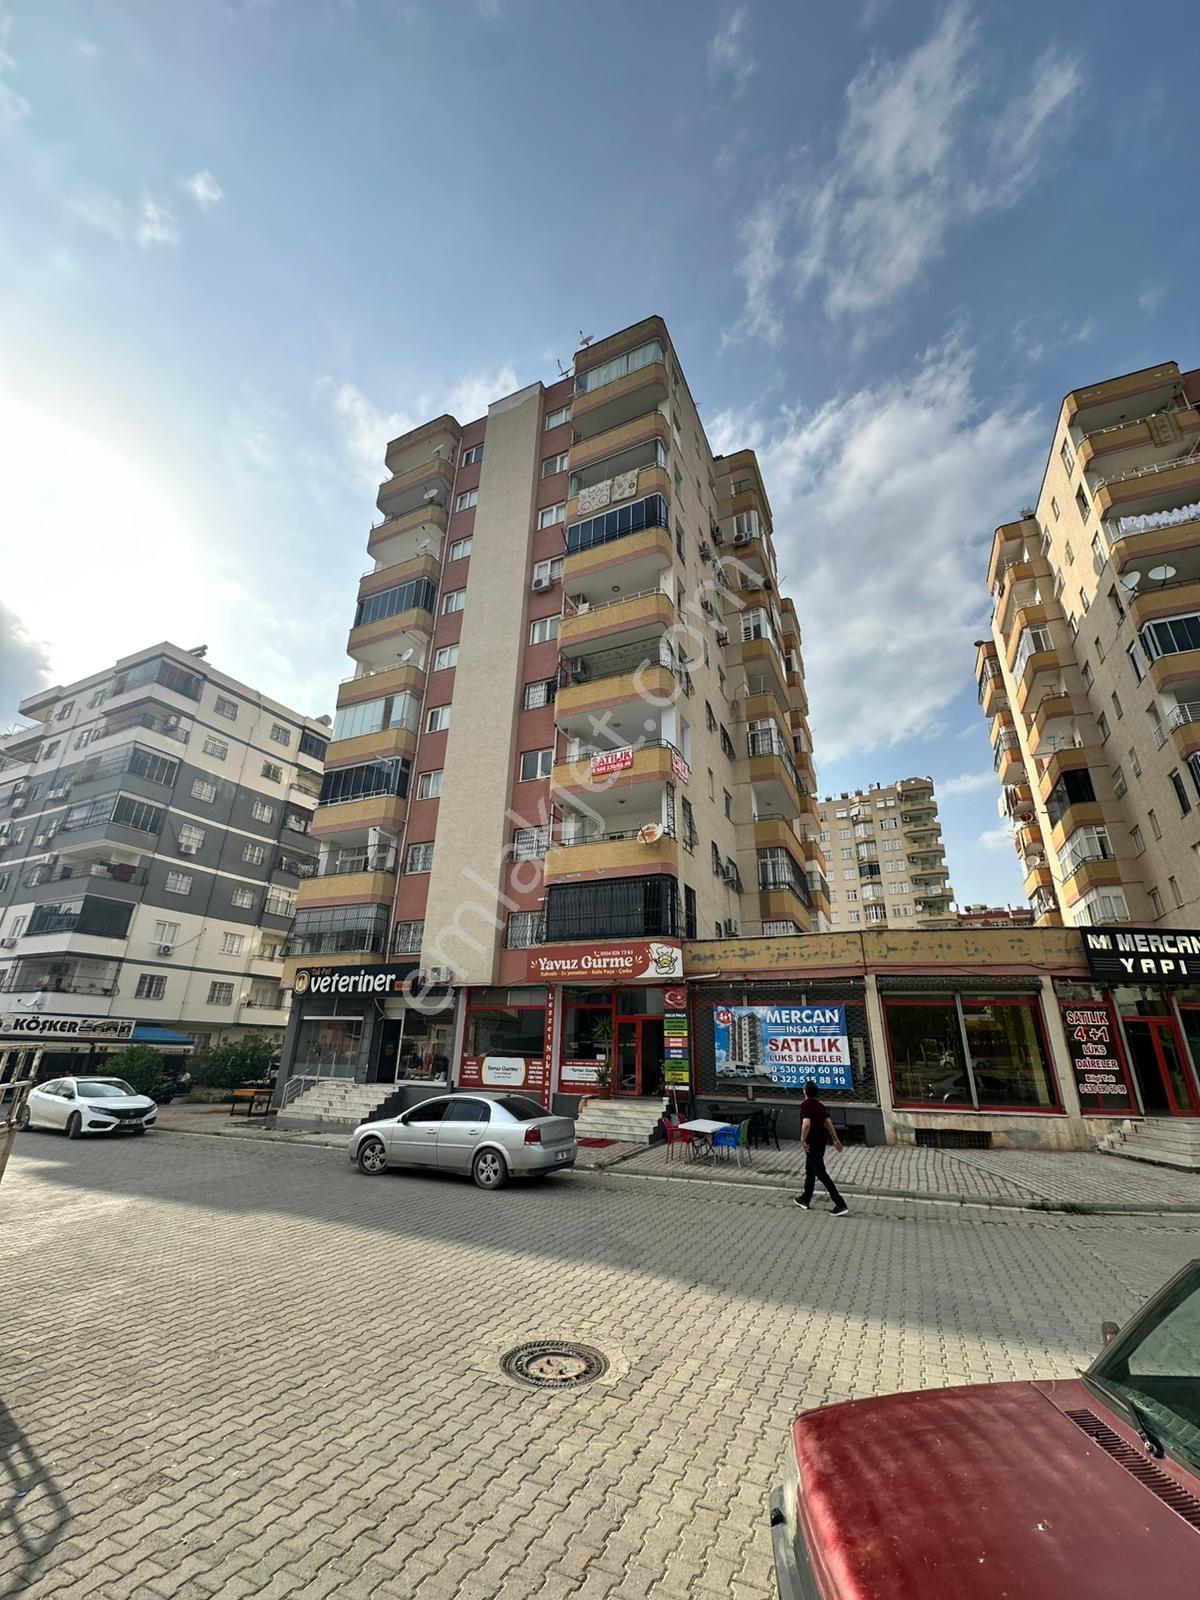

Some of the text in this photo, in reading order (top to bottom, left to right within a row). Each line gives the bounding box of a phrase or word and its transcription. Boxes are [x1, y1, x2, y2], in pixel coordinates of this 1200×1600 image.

[592, 751, 631, 768] SATILIK
[539, 955, 633, 971] Yavuz Gurme
[1120, 958, 1188, 975] YAPI
[310, 969, 396, 993] veteriner
[719, 1012, 732, 1021] 4+1
[766, 1009, 839, 1024] MERCAN
[1066, 1011, 1109, 1025] SATILIK
[13, 1016, 79, 1034] KÖŞKER
[786, 1024, 818, 1035] İNŞAAT
[769, 1037, 842, 1053] SATILIK
[796, 1053, 842, 1063] DAİRELER
[1075, 1057, 1119, 1070] DAİRELER
[772, 1065, 844, 1075] 0 530 690 60 98
[780, 1075, 797, 1083] 322
[819, 1076, 831, 1084] 88
[833, 1077, 846, 1085] 19
